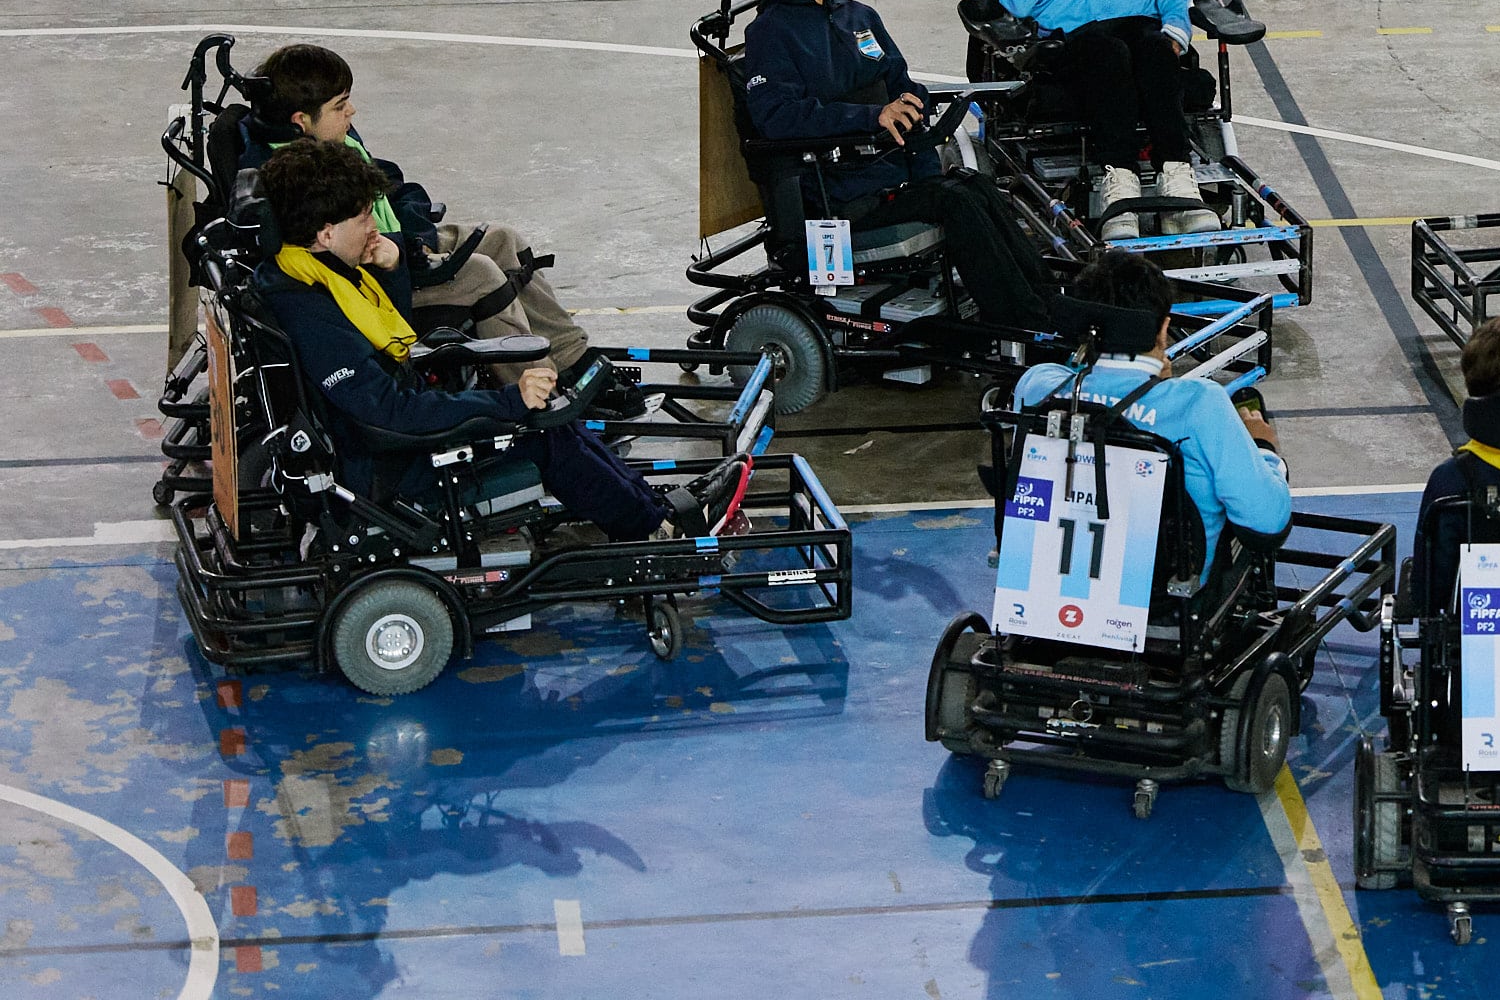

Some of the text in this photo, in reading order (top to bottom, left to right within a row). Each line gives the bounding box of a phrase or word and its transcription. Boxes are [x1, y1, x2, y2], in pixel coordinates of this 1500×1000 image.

[823, 244, 835, 265] 7
[1012, 494, 1045, 507] FIPFA
[1017, 507, 1035, 517] PF2
[1058, 517, 1107, 580] 11
[1476, 622, 1496, 632] PF2
